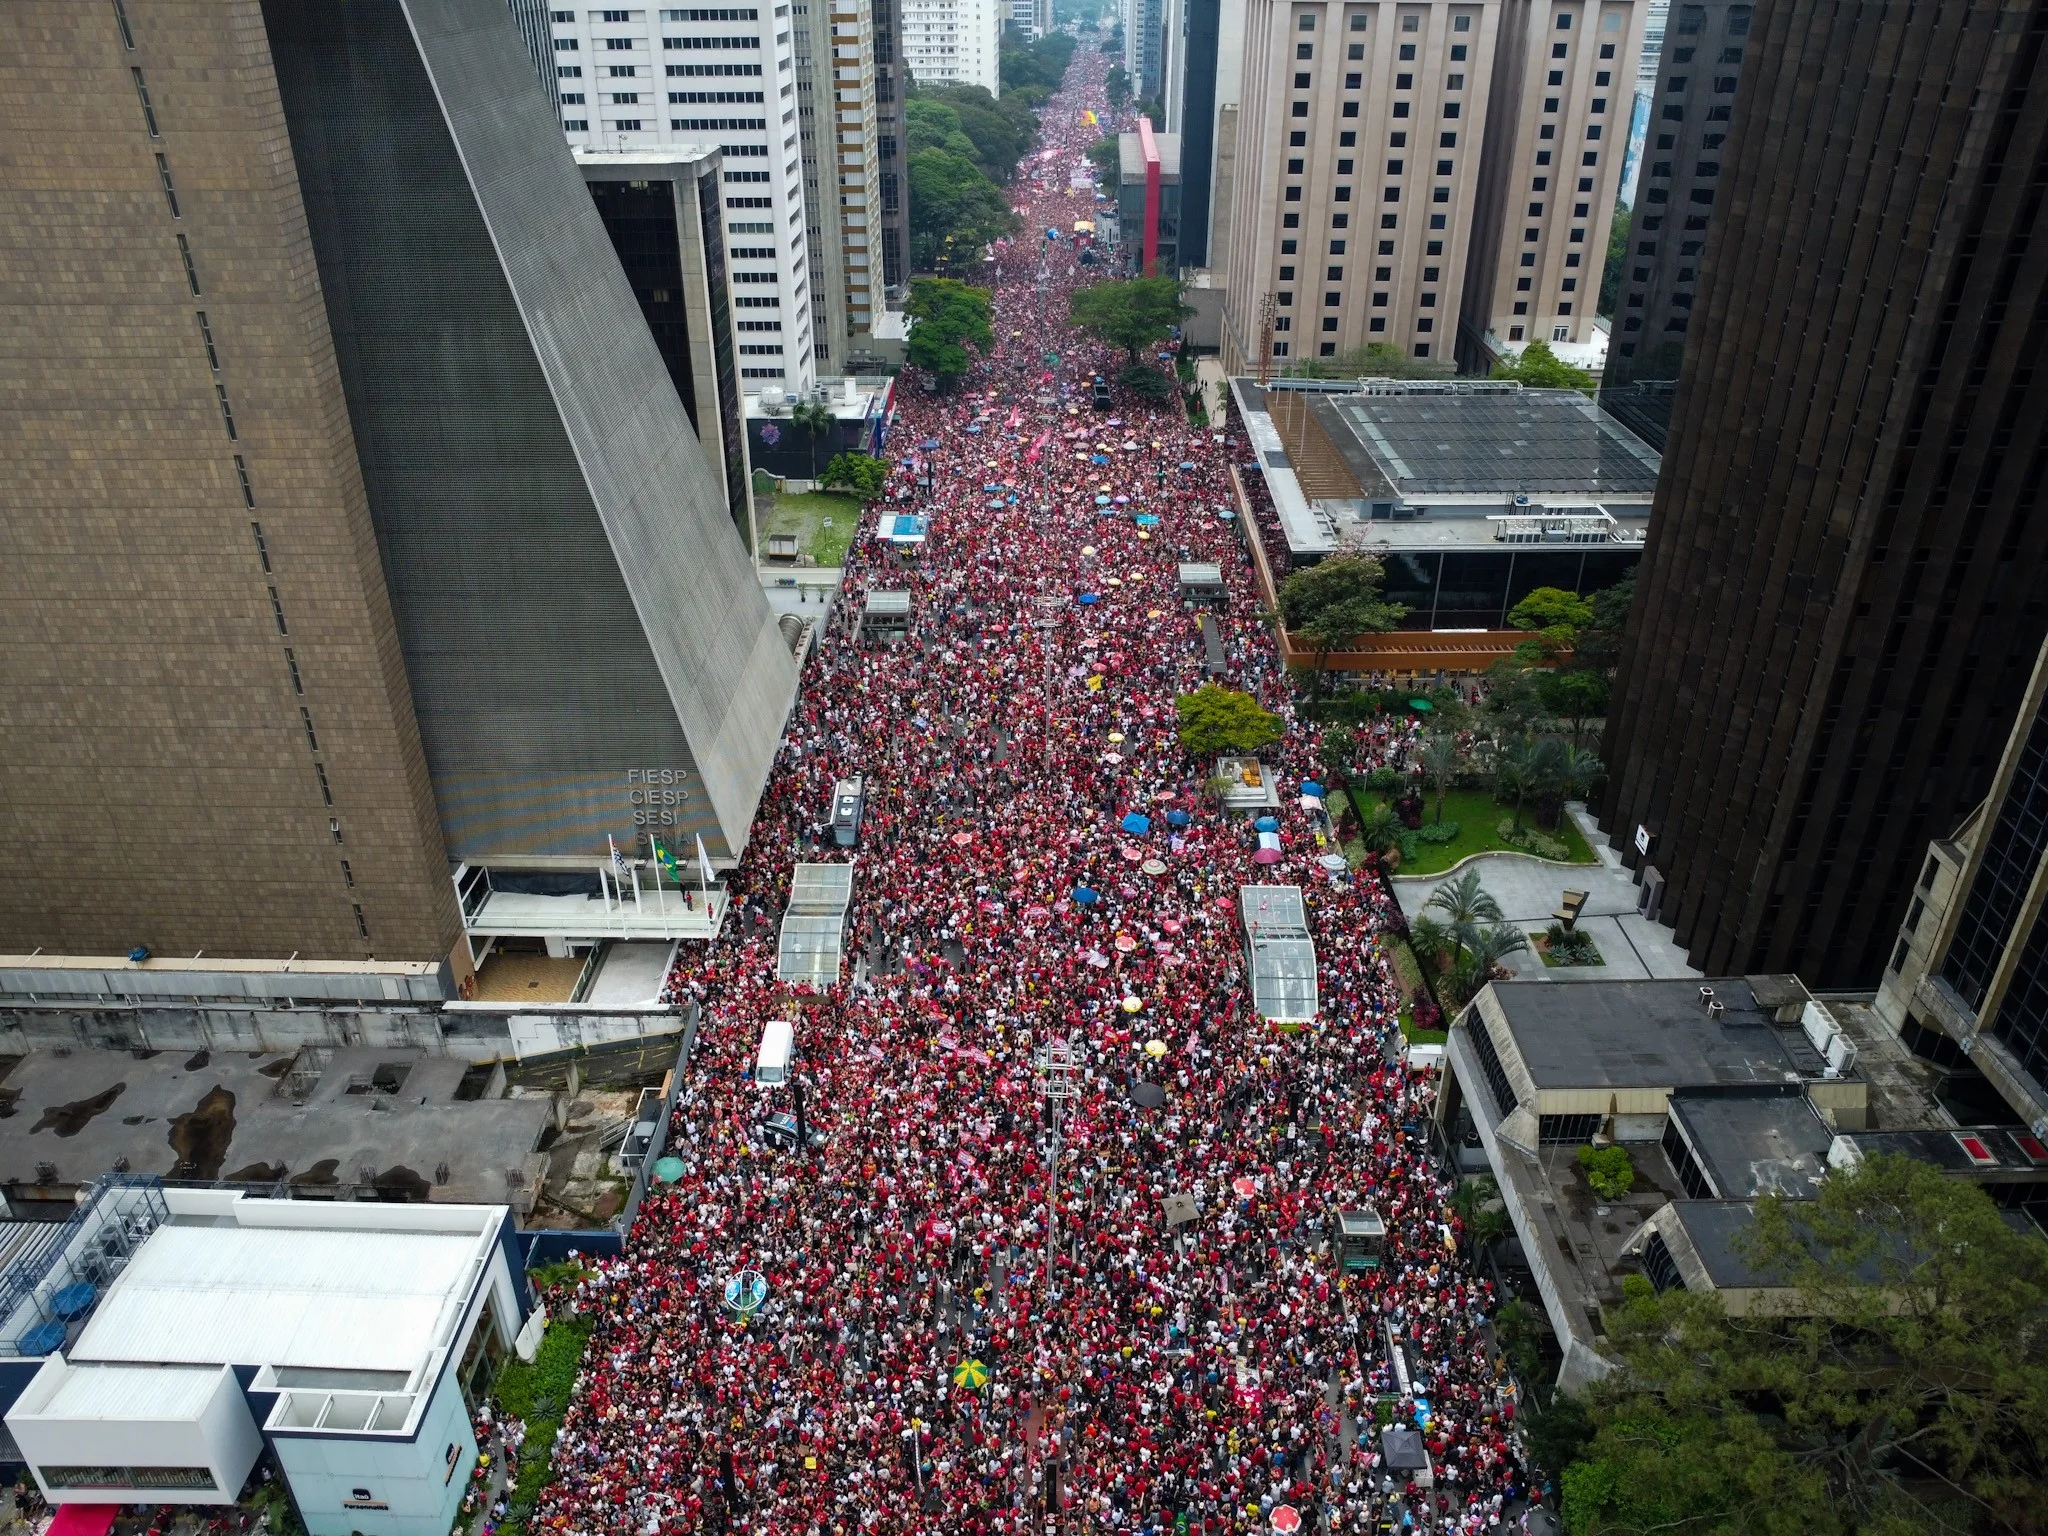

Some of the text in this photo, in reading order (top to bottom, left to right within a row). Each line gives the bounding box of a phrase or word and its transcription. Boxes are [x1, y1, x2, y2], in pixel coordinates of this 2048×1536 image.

[628, 769, 687, 784] FIESP
[629, 790, 689, 805] CIESP
[633, 810, 678, 825] SESI
